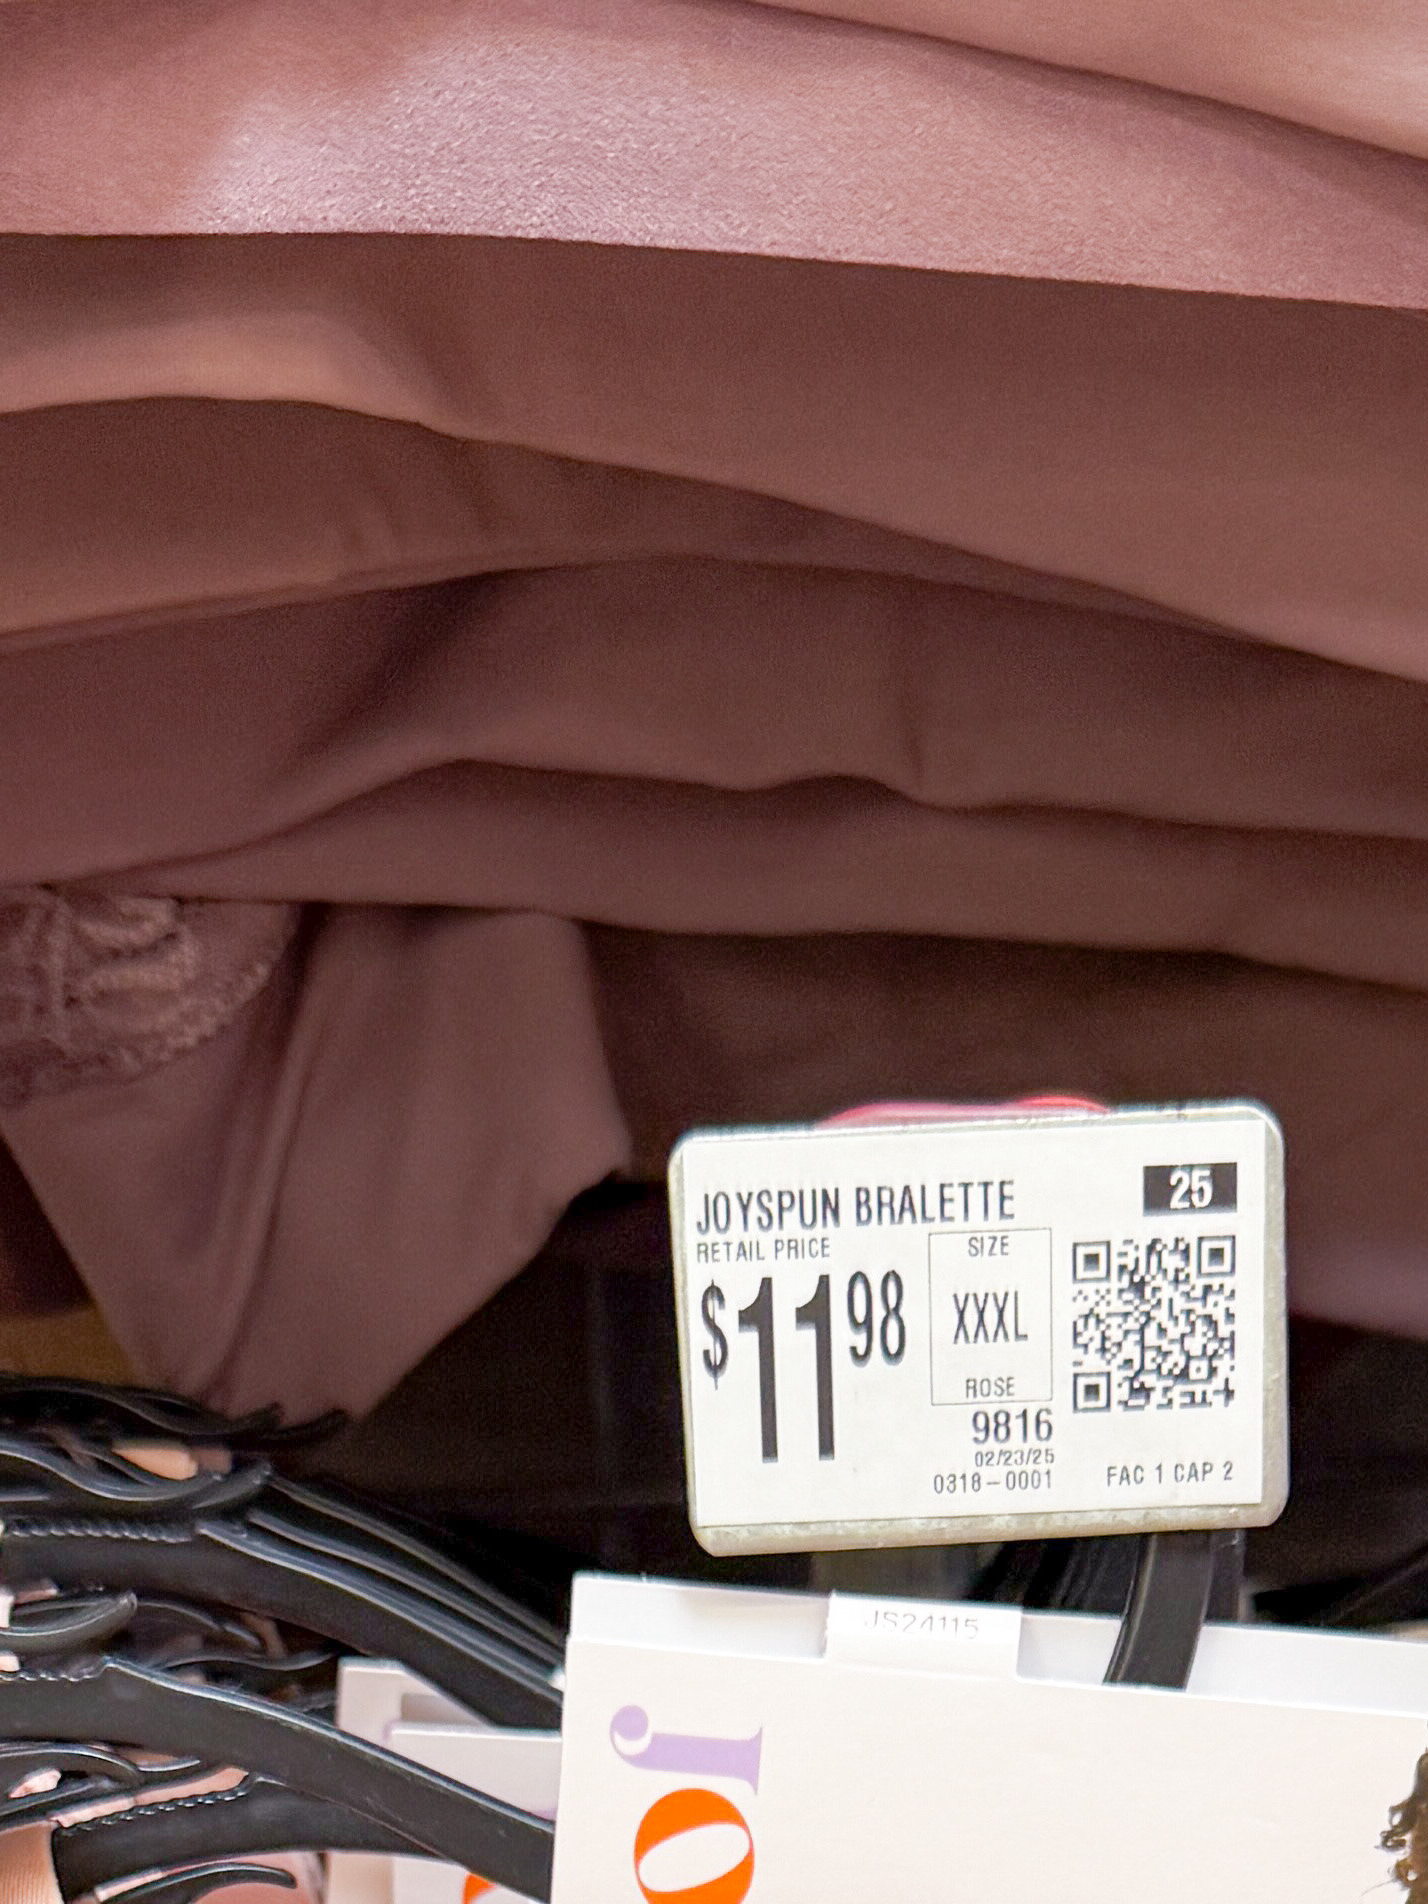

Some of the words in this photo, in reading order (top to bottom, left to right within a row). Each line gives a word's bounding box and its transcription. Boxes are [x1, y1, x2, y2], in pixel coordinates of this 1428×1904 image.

[1169, 1169, 1213, 1209] 25
[696, 1186, 841, 1235] JOYSPUN
[855, 1180, 1015, 1226] BRALETTE
[697, 1239, 766, 1263] RETAIL
[774, 1237, 831, 1260] PRICE
[967, 1235, 1010, 1257] SIZE
[952, 1293, 1028, 1345] XXXL
[965, 1376, 1015, 1399] ROSE
[971, 1408, 1054, 1445] 9816
[973, 1448, 1055, 1468] 02/23/25
[1106, 1465, 1145, 1487] FAC
[1154, 1463, 1163, 1484] 1
[1173, 1462, 1214, 1483] CAP
[1222, 1460, 1234, 1482] 2
